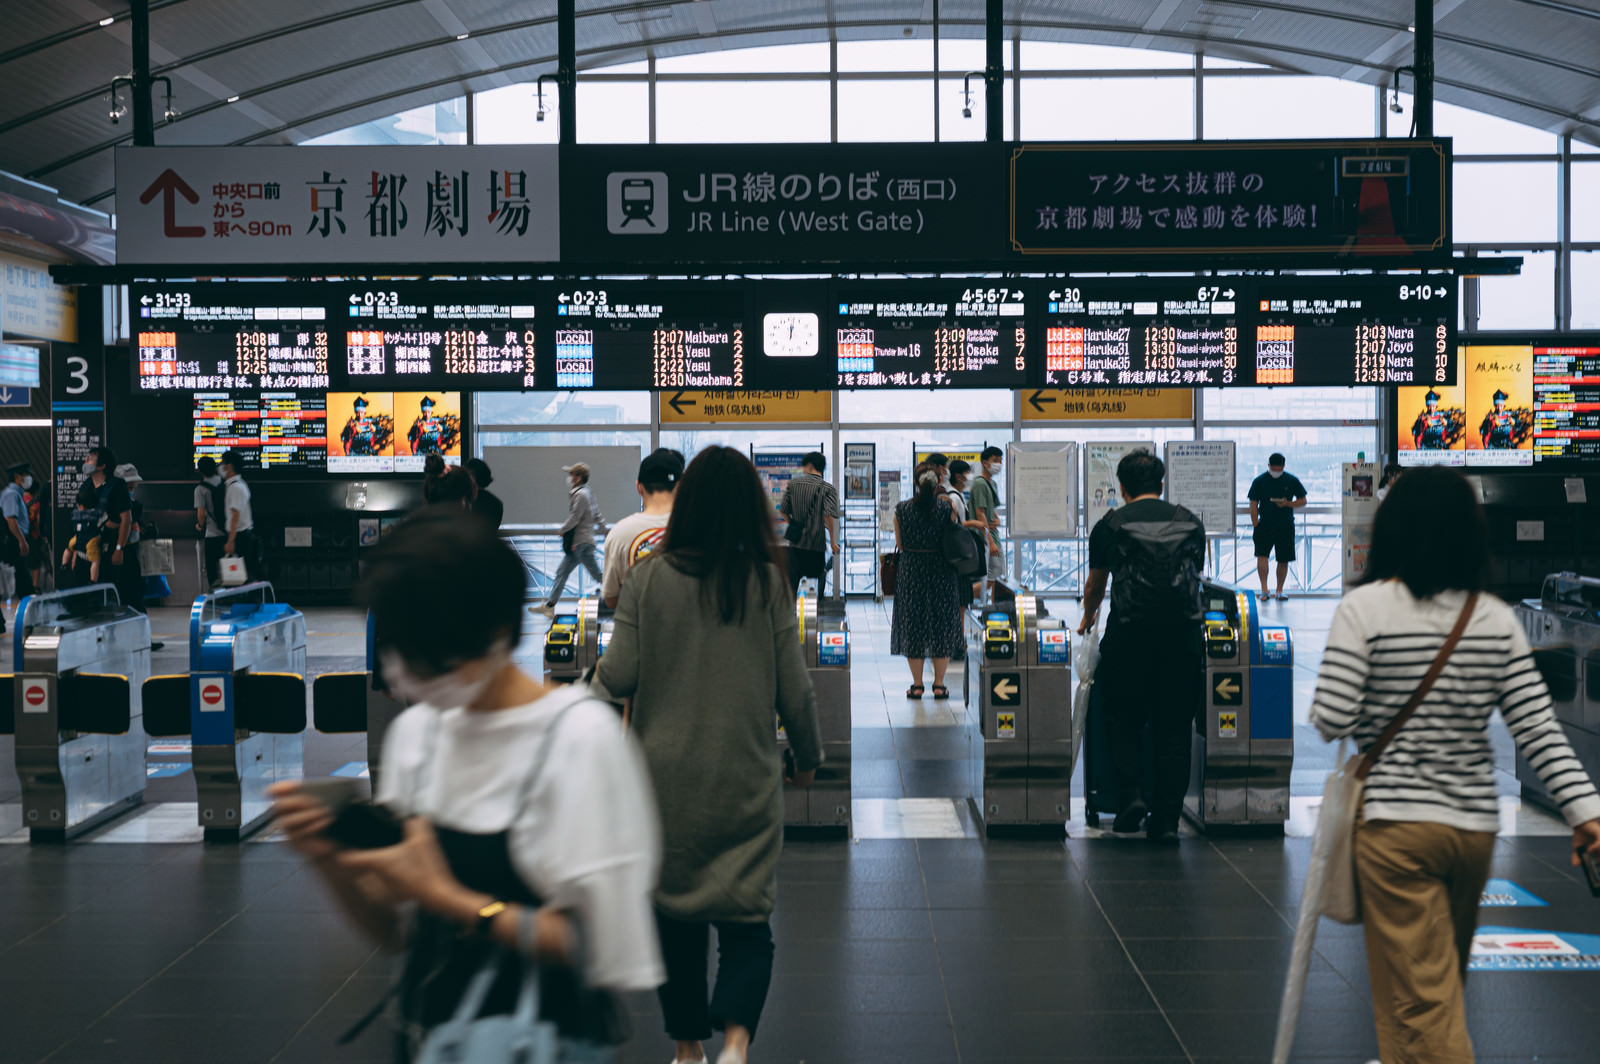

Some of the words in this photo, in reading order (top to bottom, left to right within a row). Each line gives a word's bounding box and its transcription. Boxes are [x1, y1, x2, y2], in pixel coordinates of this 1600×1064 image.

[212, 182, 280, 200] 中央口前
[1088, 172, 1264, 196] アクセス抜群の
[213, 202, 245, 218] から
[305, 169, 531, 238] 京都劇場
[687, 212, 712, 233] JR
[722, 210, 770, 232] Line
[778, 210, 849, 235] (West
[857, 209, 924, 235] Gate)
[1036, 204, 1318, 230] 京都劇場で感動を体験!
[213, 221, 292, 238] 東へ90m
[1064, 288, 1080, 302] 30
[1399, 285, 1432, 300] 8-10
[156, 293, 191, 307] 31-33
[236, 332, 266, 346] 12:08
[314, 332, 328, 346] 32
[444, 331, 476, 344] 12:10
[653, 330, 684, 344] 12:07
[685, 330, 728, 344] Maibara
[734, 330, 743, 344] 2
[934, 328, 966, 342] 12:09
[1144, 327, 1176, 341] 12:30
[1224, 327, 1237, 340] 30
[1356, 326, 1386, 340] 12:03
[1387, 326, 1414, 339] Nara
[1436, 325, 1446, 339] 8
[236, 347, 266, 360] 12:12
[316, 346, 328, 360] 33
[444, 345, 475, 359] 12:11
[525, 345, 535, 359] 3
[653, 344, 684, 358] 12:15
[685, 344, 711, 358] Yasu
[734, 344, 744, 358] 2
[909, 344, 920, 358] 16
[934, 343, 964, 356] 12:11
[1016, 342, 1025, 356] 7
[1144, 341, 1176, 355] 13:30
[1224, 341, 1237, 355] 30
[1355, 340, 1386, 354] 12:07
[1436, 340, 1446, 354] 9
[236, 361, 268, 374] 12:25
[316, 361, 328, 374] 31
[444, 360, 476, 374] 12:26
[525, 360, 535, 373] 3
[653, 359, 684, 372] 12:22
[685, 358, 711, 372] Yasu
[734, 358, 744, 372] 2
[934, 357, 965, 371] 12:15
[1144, 356, 1176, 370] 14:30
[1224, 356, 1237, 369] 30
[1355, 354, 1386, 368] 12:19
[1386, 354, 1414, 368] Nara
[1435, 354, 1448, 368] 10
[66, 356, 90, 394] 3
[654, 373, 684, 387] 12:30
[685, 372, 732, 387] Nagahama
[734, 372, 744, 386] 2
[1354, 368, 1386, 382] 12:33
[1386, 368, 1414, 382] Nara
[1436, 368, 1446, 382] 8
